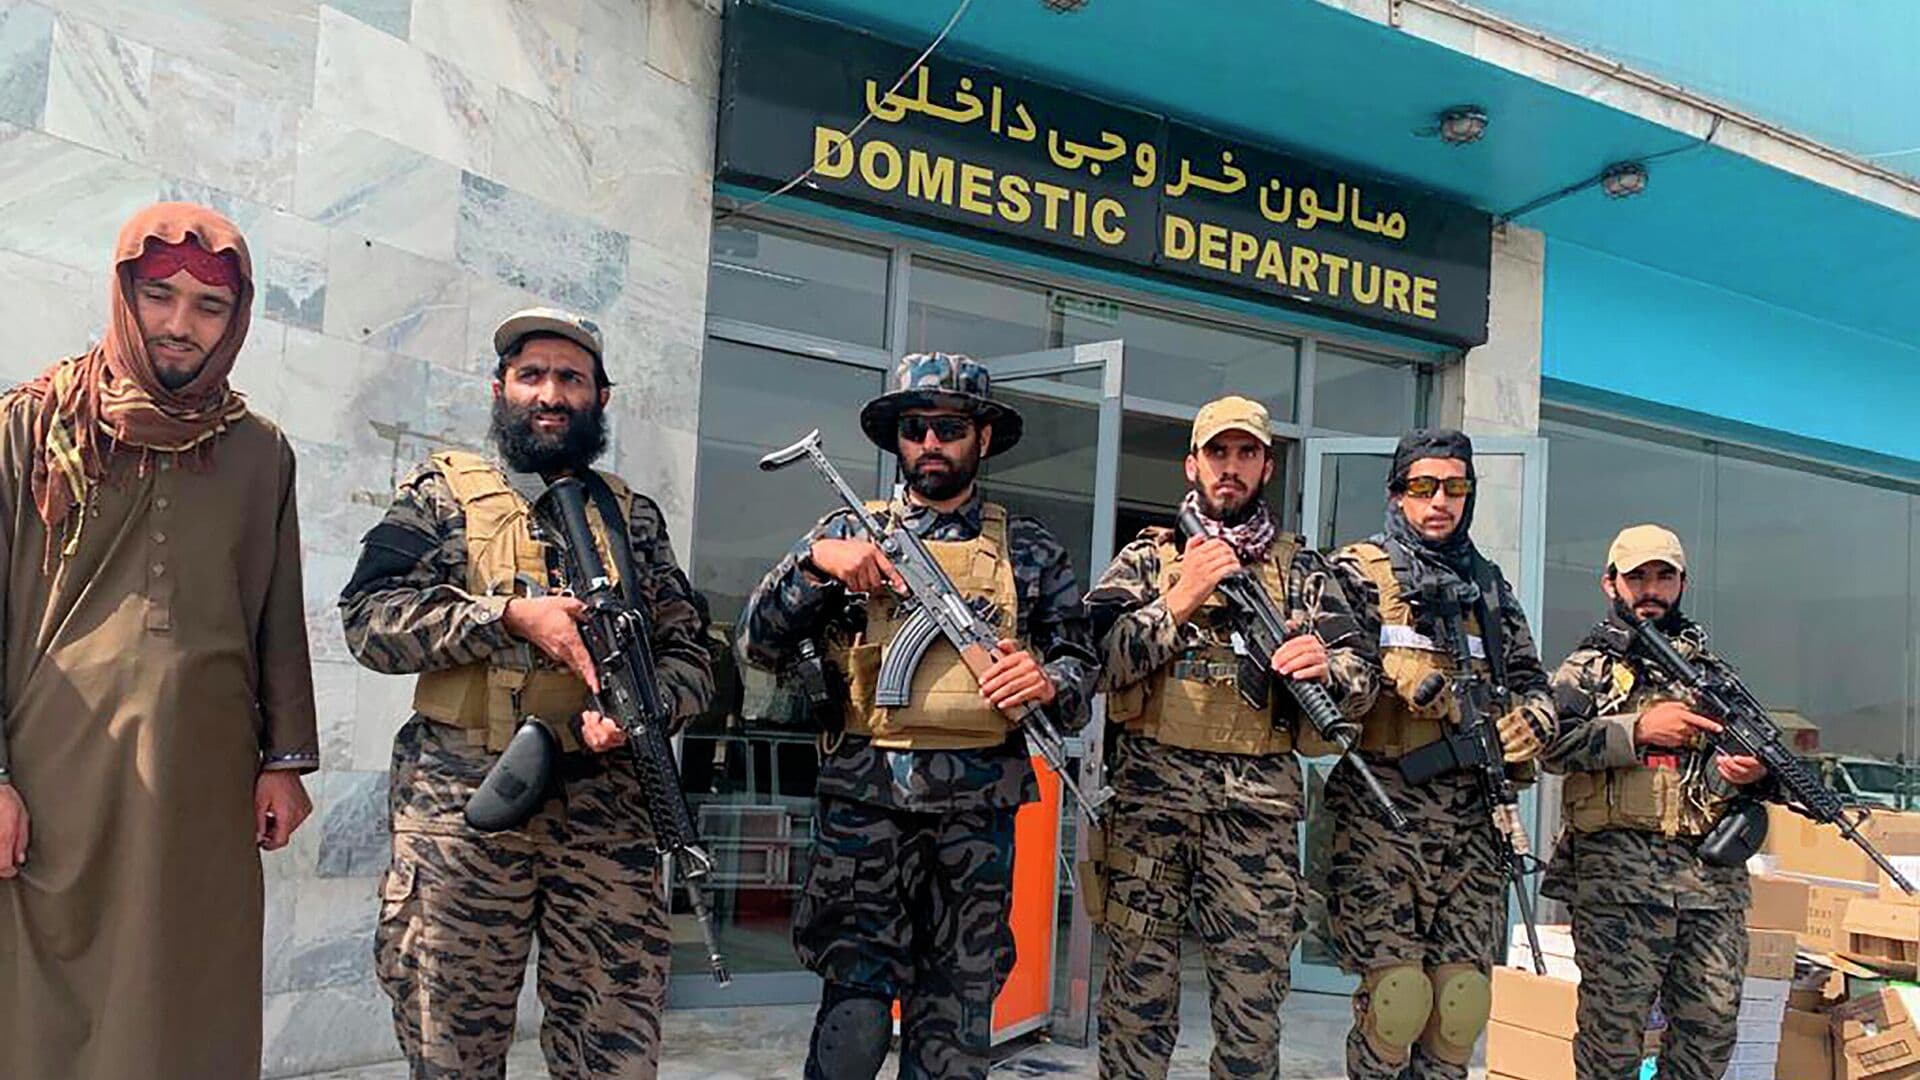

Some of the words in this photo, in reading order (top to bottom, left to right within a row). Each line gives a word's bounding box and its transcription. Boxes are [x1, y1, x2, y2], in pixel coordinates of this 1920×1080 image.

[865, 65, 1037, 142] داخلی
[813, 126, 1126, 244] DOMESTIC
[1164, 214, 1438, 319] DEPARTURE
[1259, 178, 1406, 239] صالون
